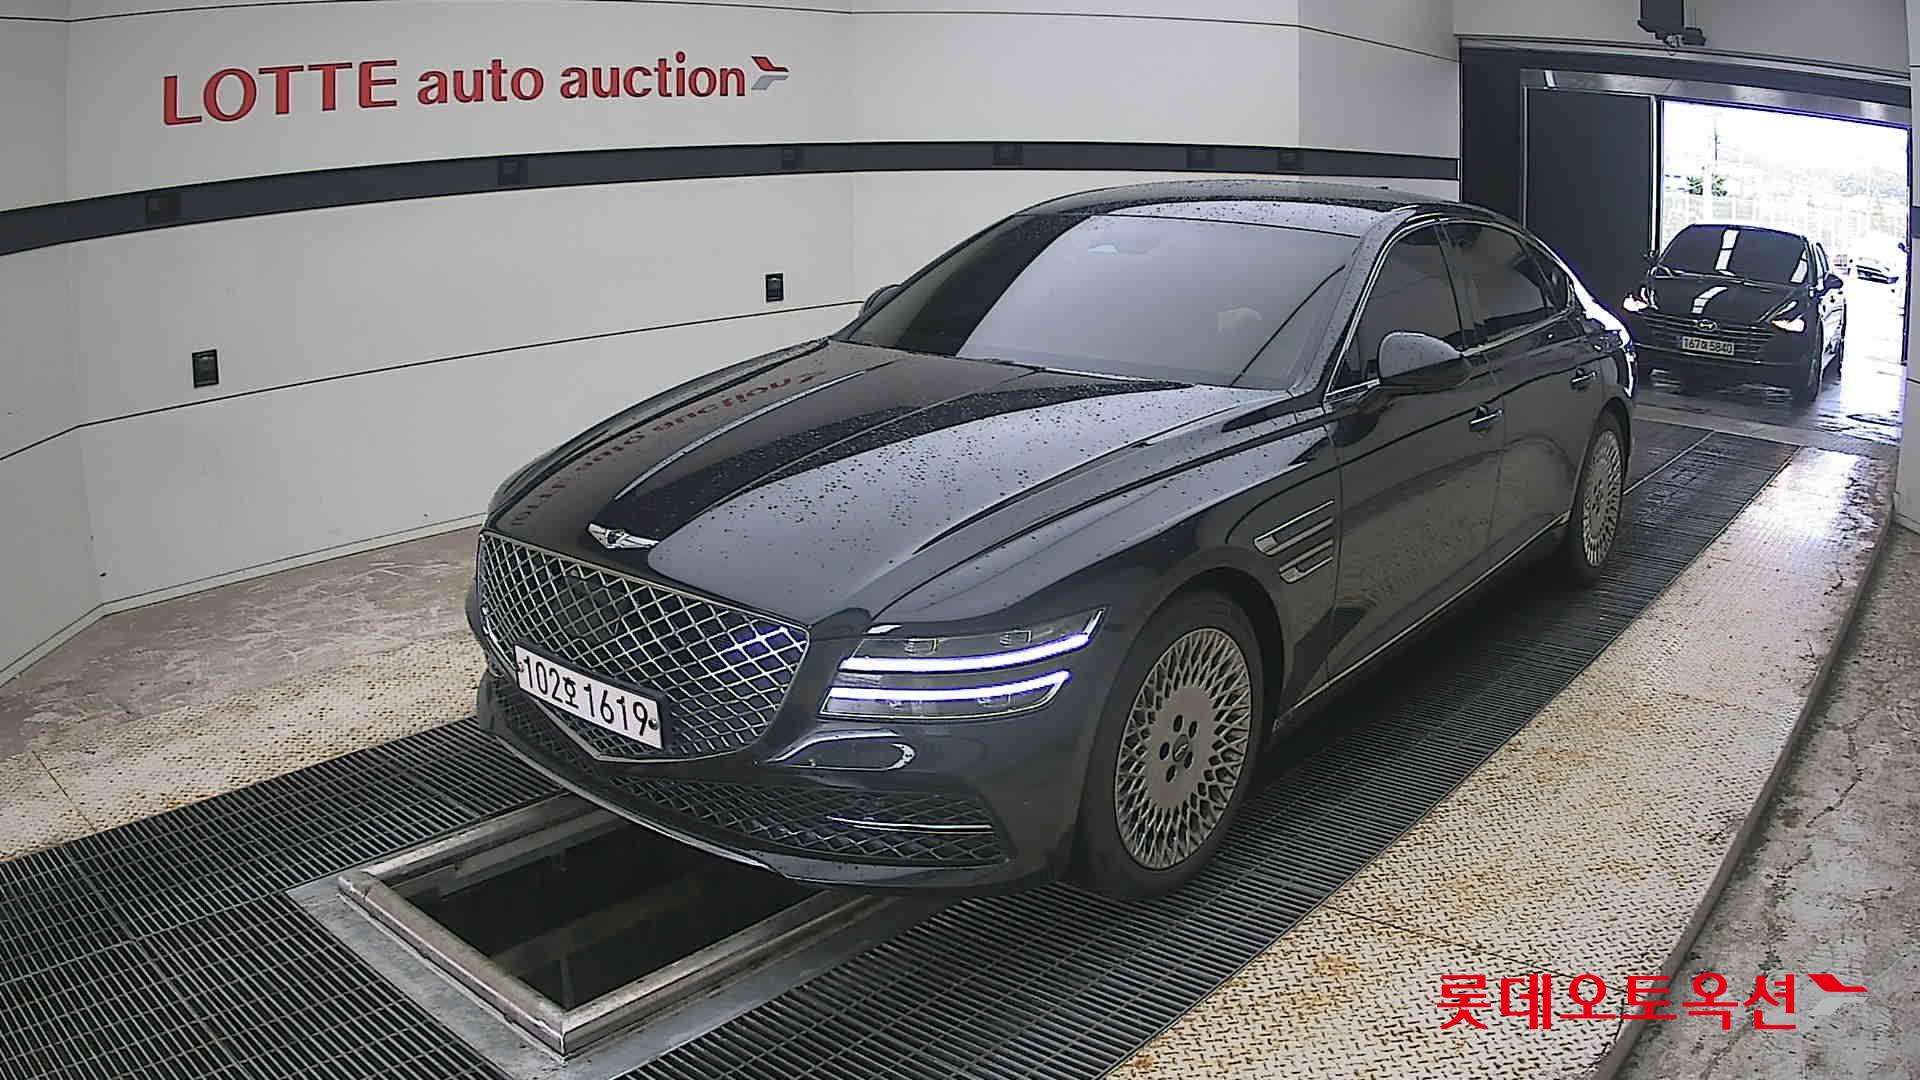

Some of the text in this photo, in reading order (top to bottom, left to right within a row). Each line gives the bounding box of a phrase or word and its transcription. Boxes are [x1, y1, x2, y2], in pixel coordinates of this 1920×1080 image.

[162, 51, 746, 126] LOTTE auto auction
[523, 655, 648, 736] 102호 1619
